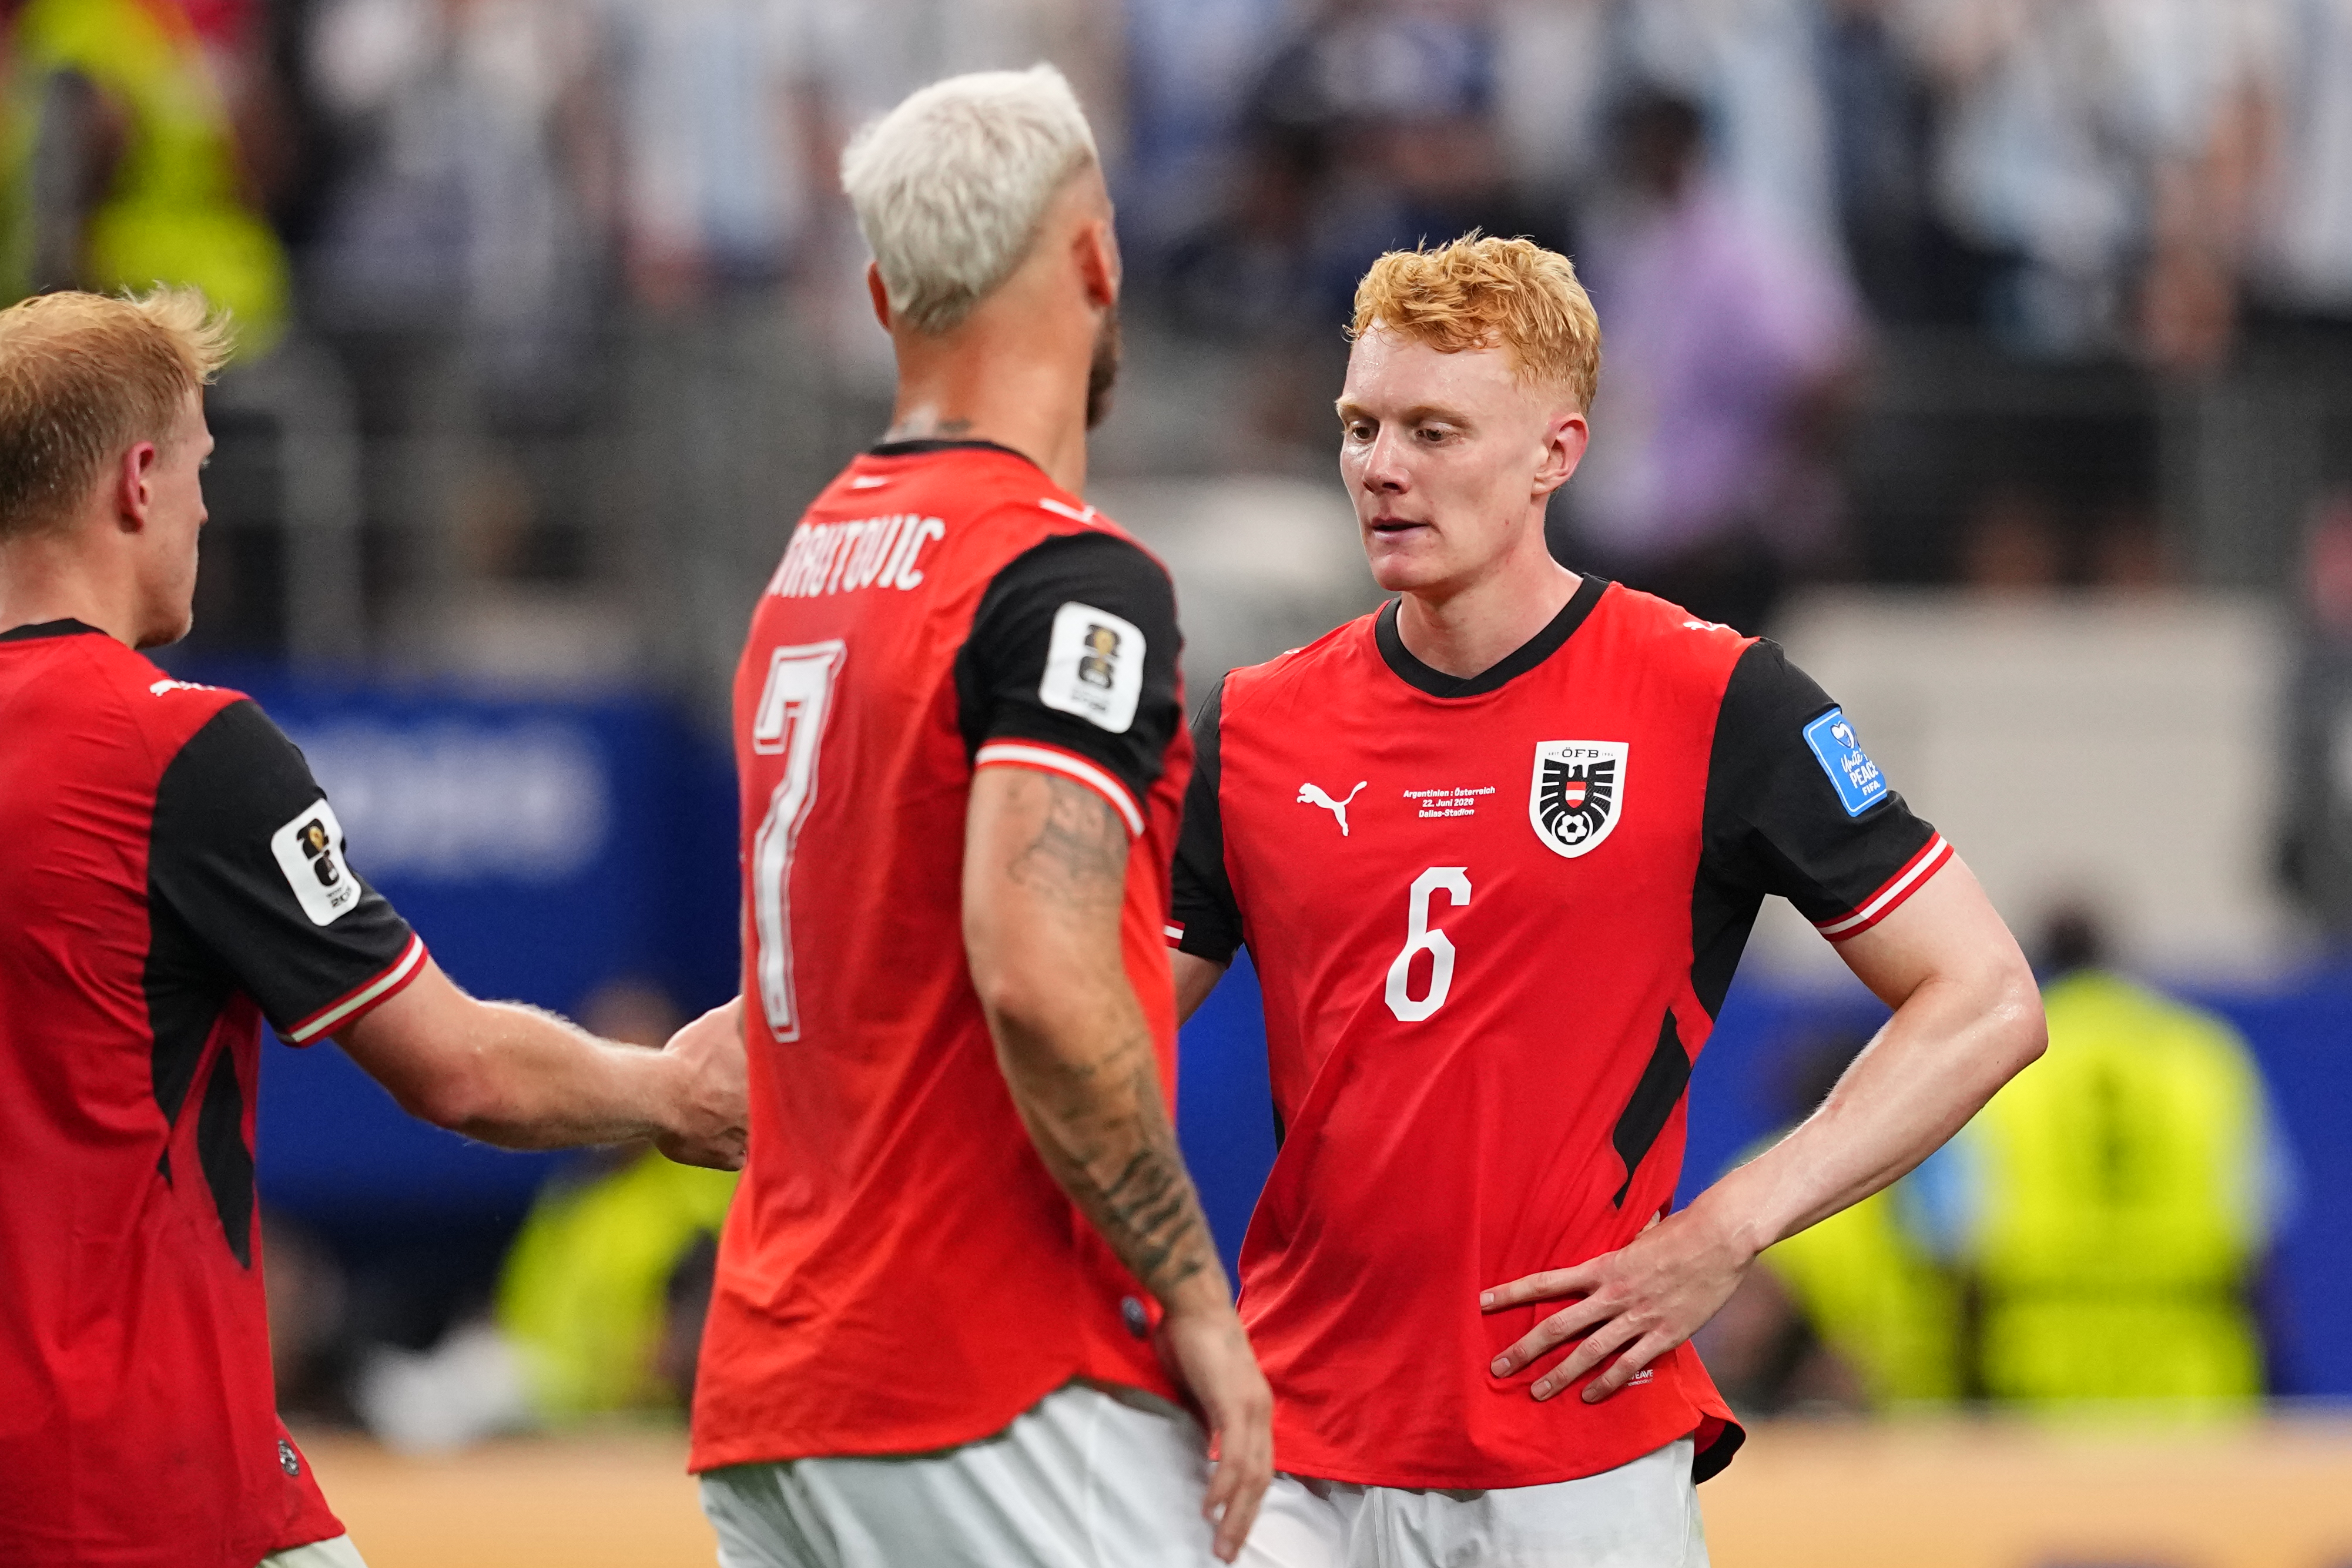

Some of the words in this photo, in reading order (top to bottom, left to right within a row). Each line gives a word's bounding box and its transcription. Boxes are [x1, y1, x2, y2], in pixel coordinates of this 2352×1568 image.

[1562, 747, 1599, 758] ÖFB
[1403, 789, 1449, 799] Argentinien
[1454, 786, 1496, 796] Österreich
[1862, 780, 1881, 796] FIFA
[1422, 799, 1435, 808] 22.
[1435, 798, 1453, 807] Juni
[1453, 798, 1475, 806] 2026
[1418, 808, 1475, 817] Dallas-Stadion
[753, 638, 847, 1044] 7
[1384, 866, 1472, 1021] 6
